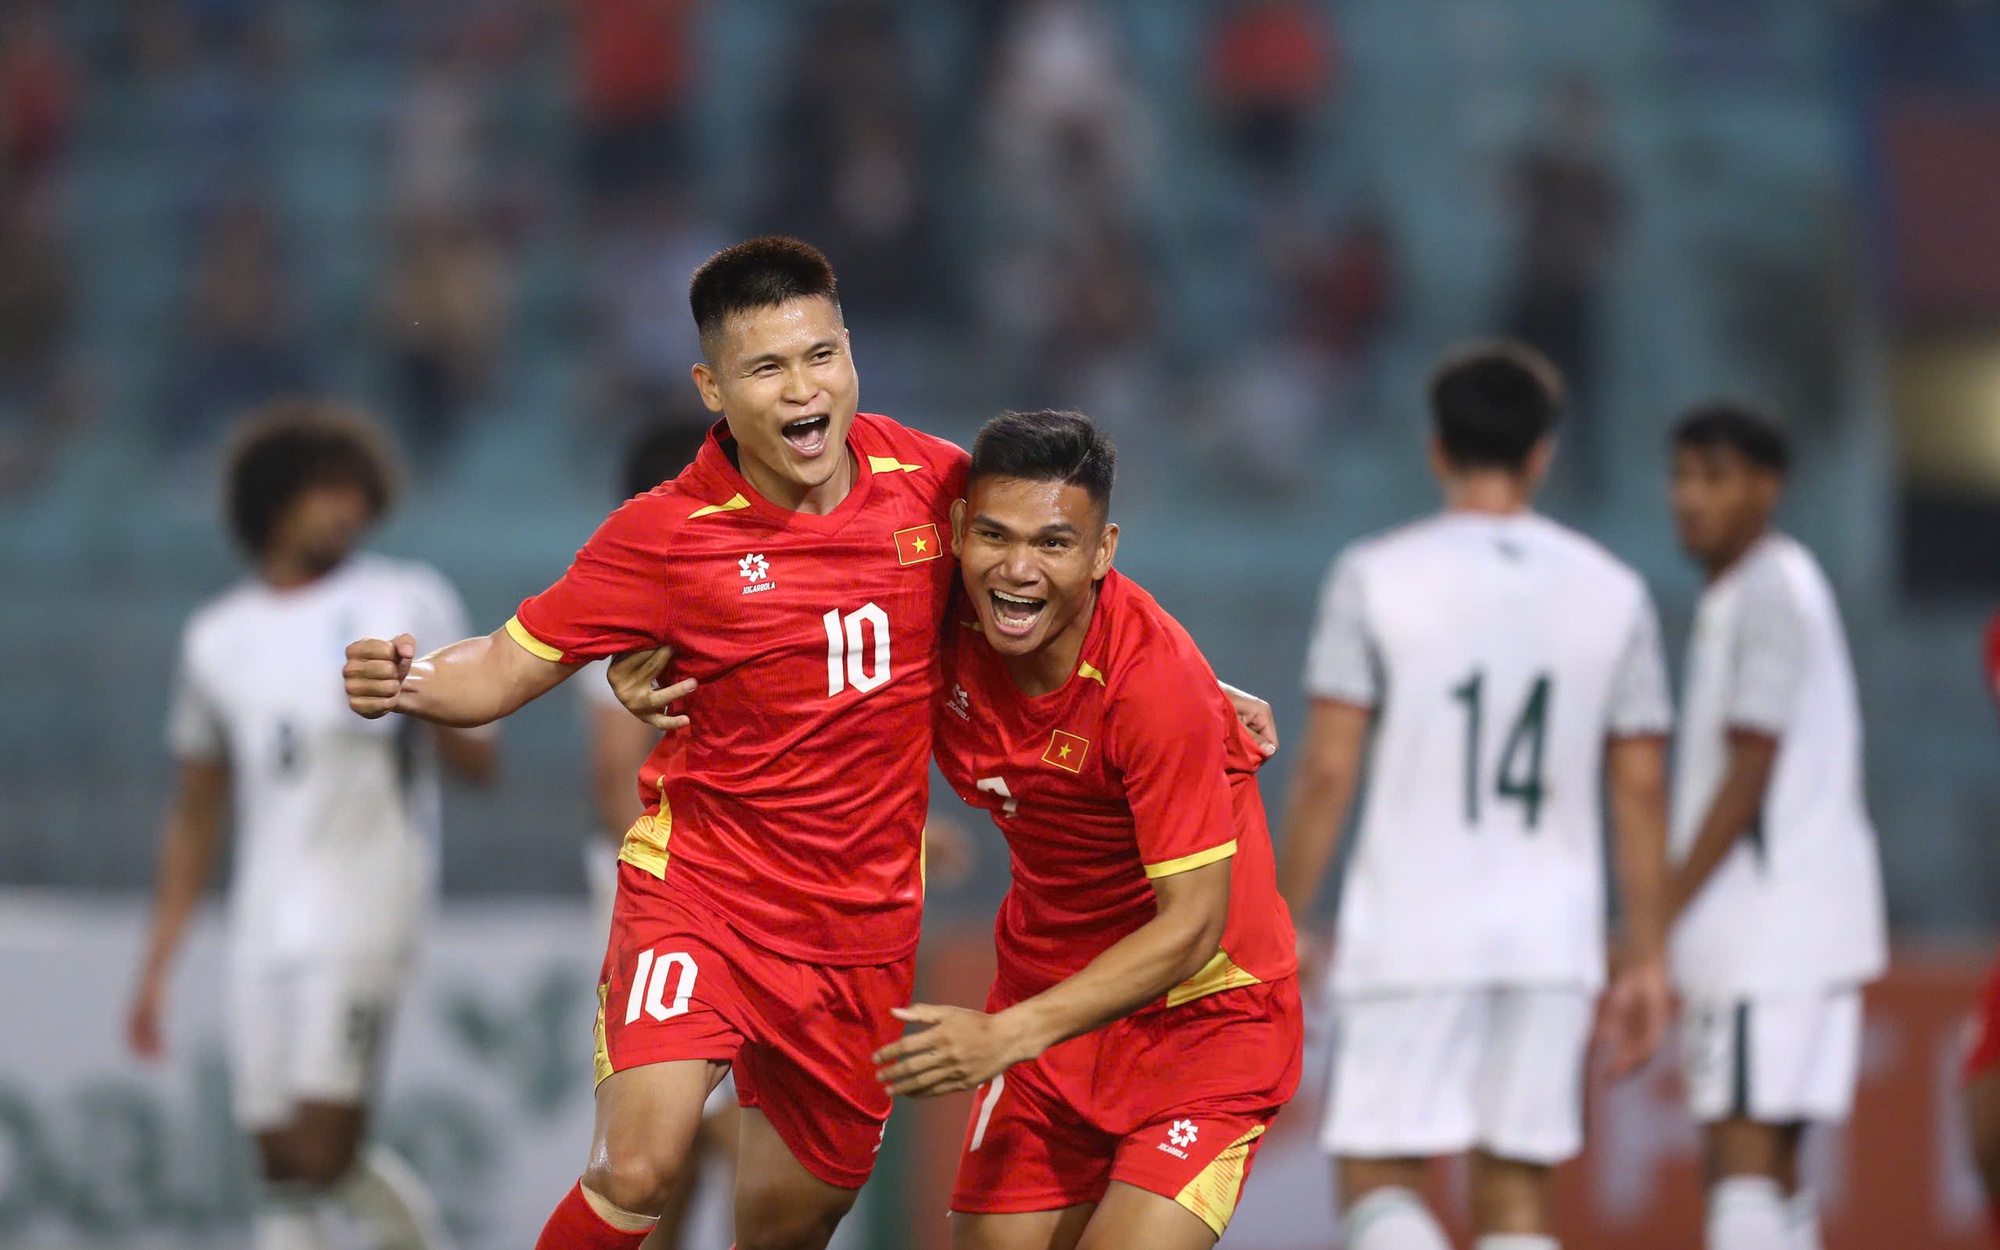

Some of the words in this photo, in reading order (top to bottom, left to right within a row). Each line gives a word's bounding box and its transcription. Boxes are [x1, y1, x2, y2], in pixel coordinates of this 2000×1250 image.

[742, 581, 777, 595] JOGARBOLA
[823, 602, 891, 698] 10
[1450, 671, 1550, 826] 14
[625, 948, 699, 1026] 10
